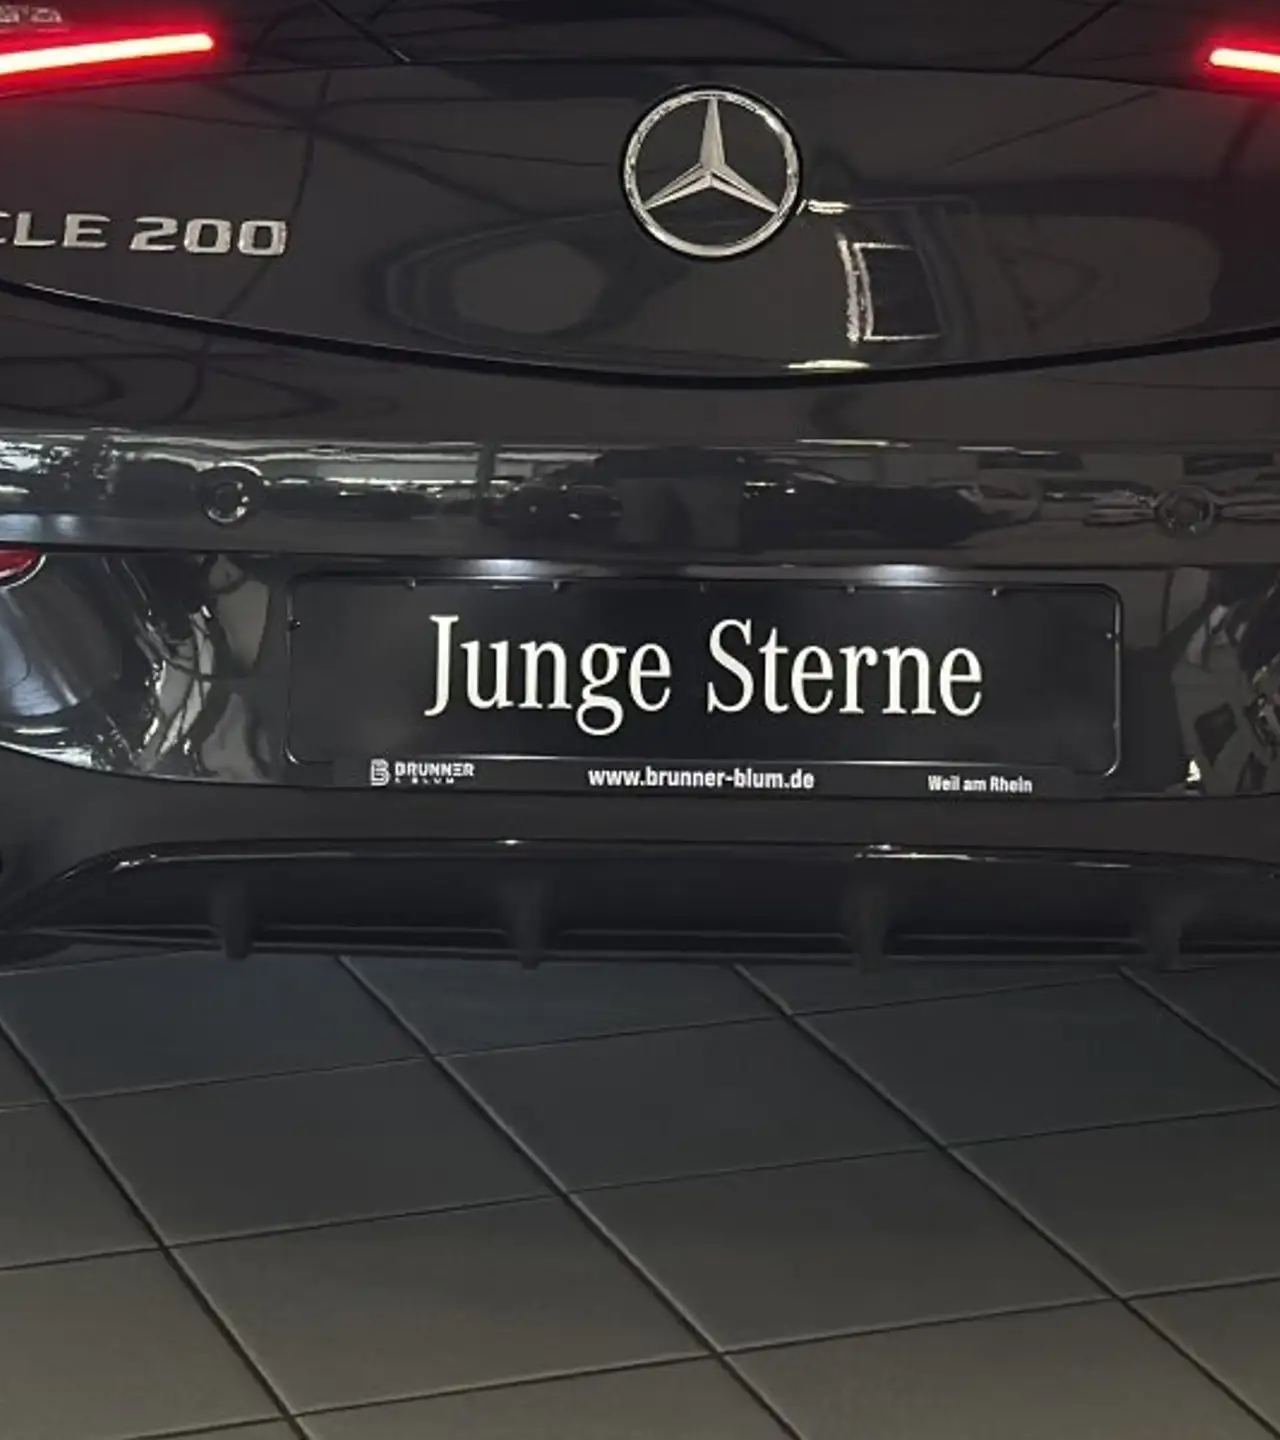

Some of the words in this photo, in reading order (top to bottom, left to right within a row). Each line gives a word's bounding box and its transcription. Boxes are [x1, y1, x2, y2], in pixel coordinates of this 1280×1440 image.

[129, 216, 288, 257] 200
[423, 614, 671, 736] Junge
[707, 618, 982, 716] Sterne
[394, 761, 475, 777] BRUNNER
[587, 765, 815, 789] www.brunner-blum.de
[927, 774, 961, 791] Weil
[962, 779, 987, 792] am
[989, 775, 1033, 793] Rhein
